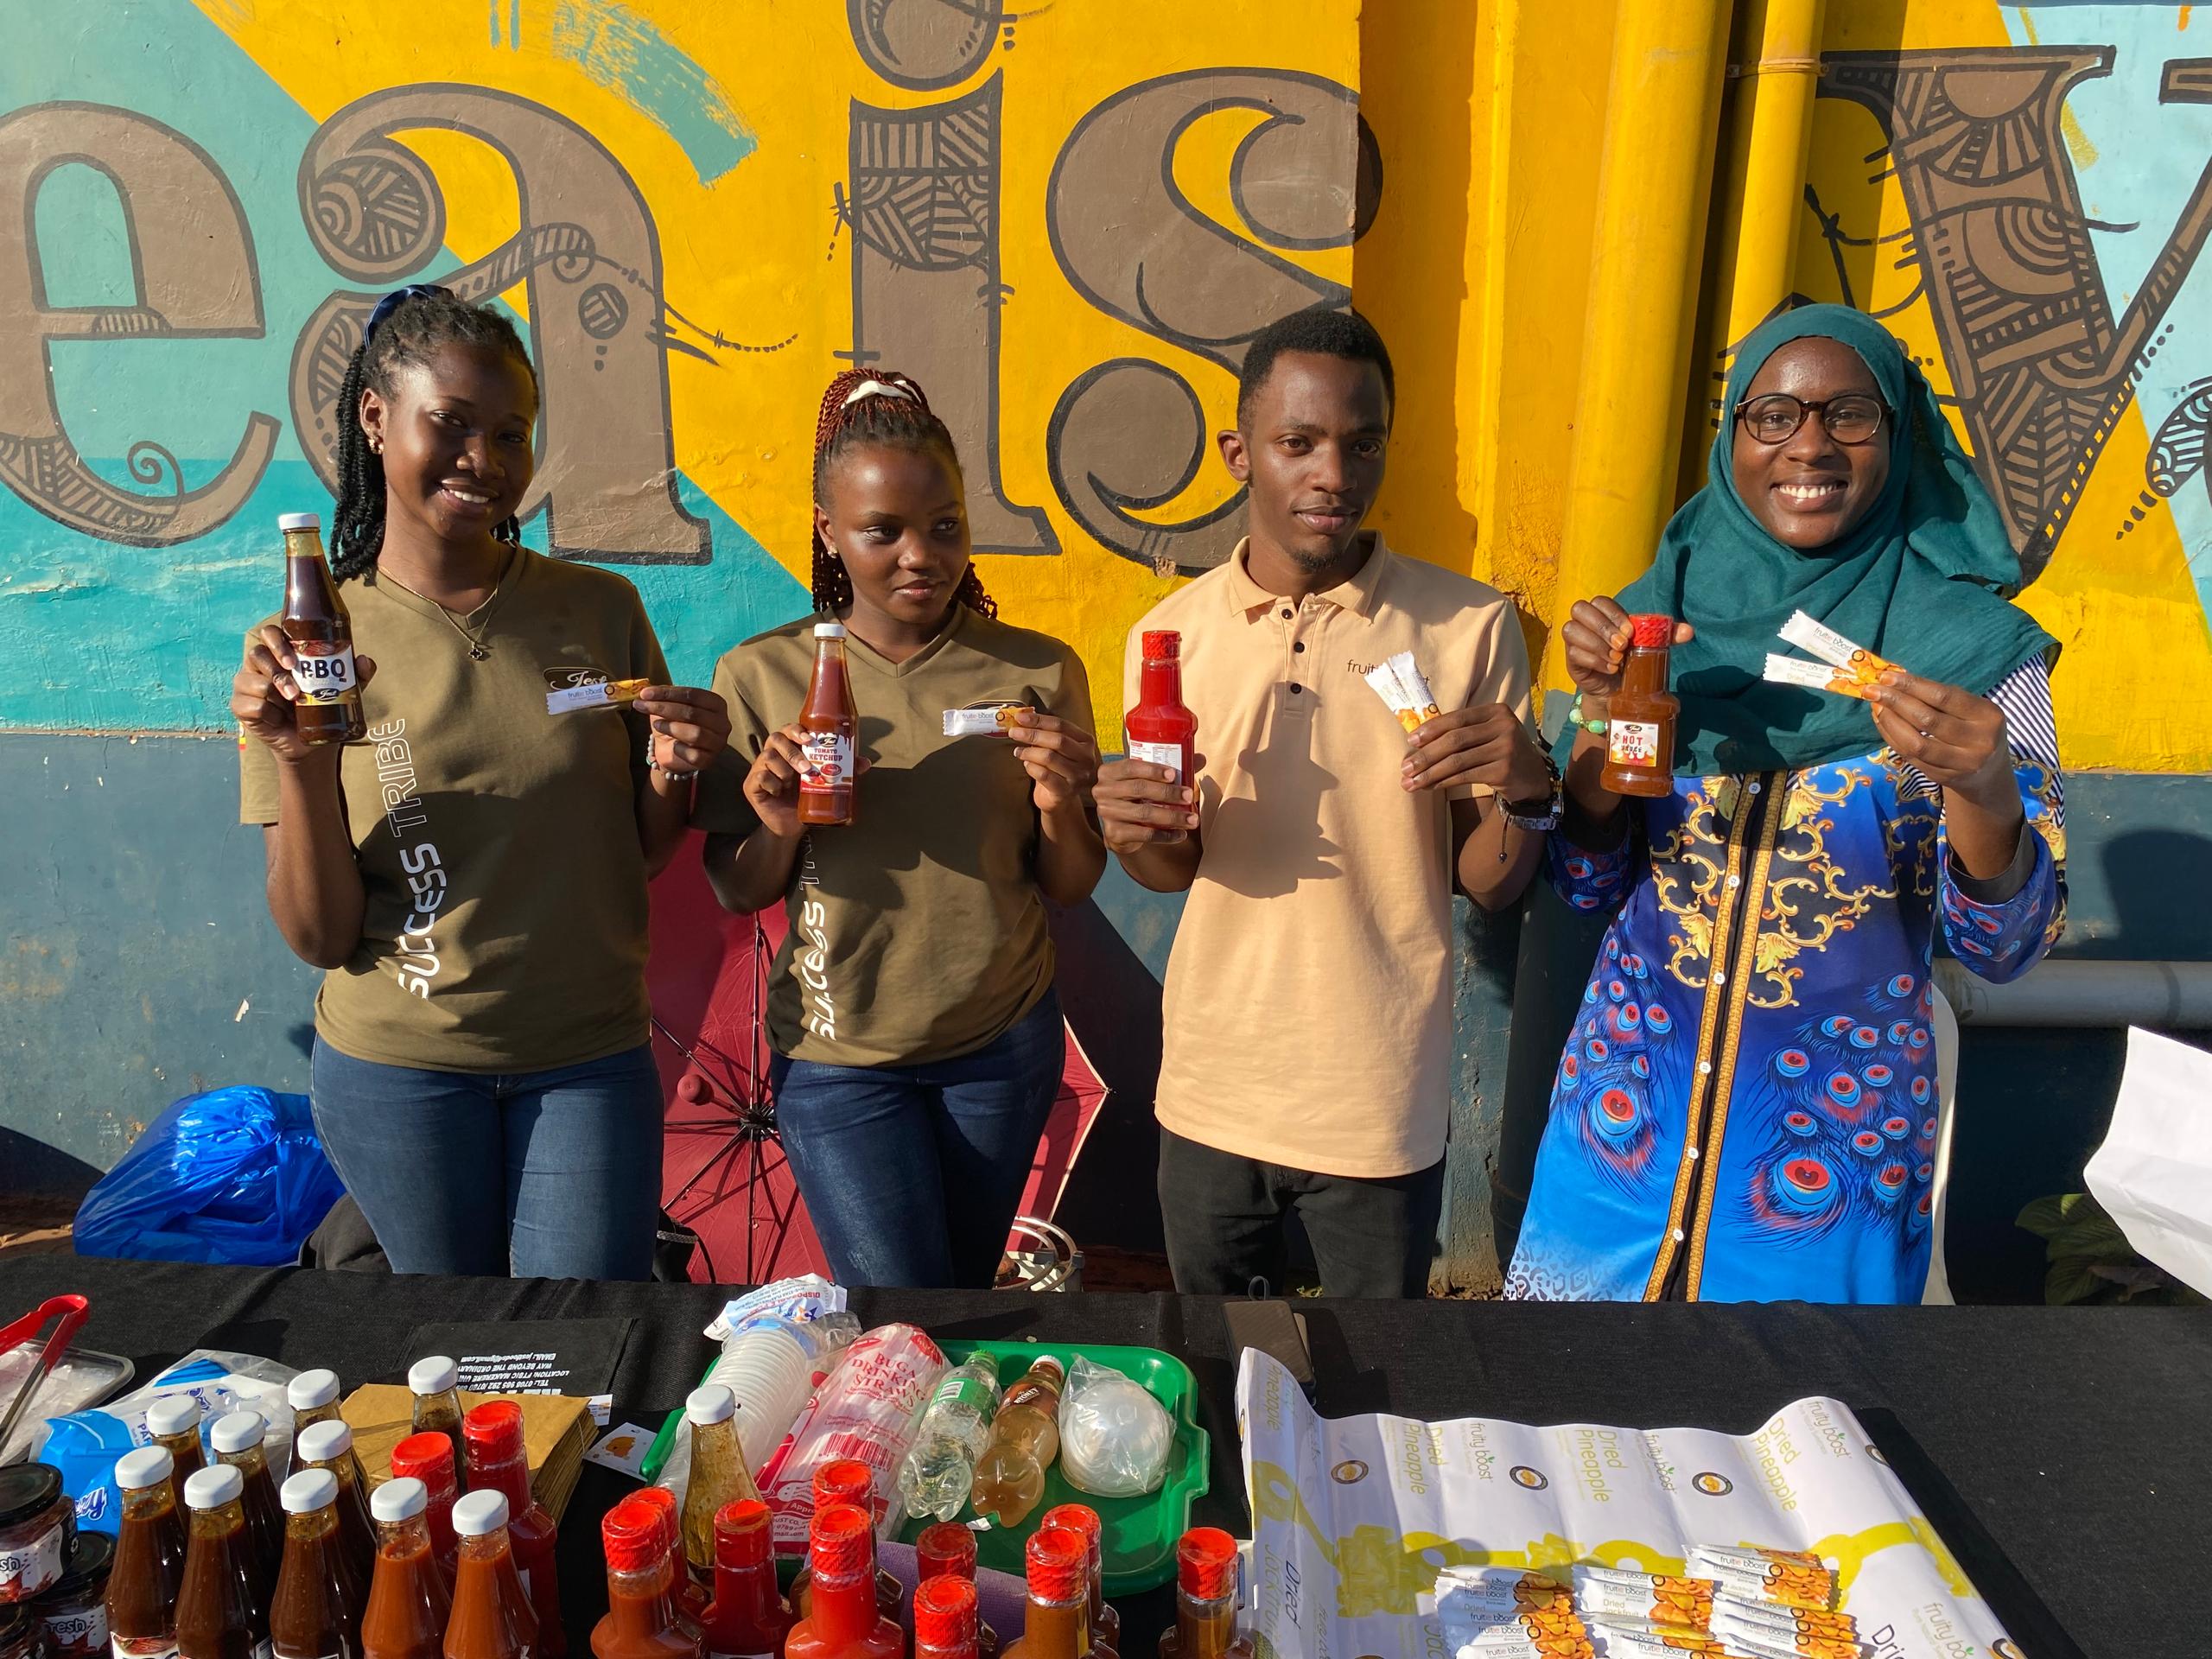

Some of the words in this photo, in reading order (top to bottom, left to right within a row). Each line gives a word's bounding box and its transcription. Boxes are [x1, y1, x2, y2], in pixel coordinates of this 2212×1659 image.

[809, 753, 843, 762] KETCHUP
[1623, 735, 1643, 746] HOT
[367, 718, 427, 838] TRIBE
[397, 842, 448, 1001] SUCCESS
[533, 1370, 570, 1378] LOCATION:
[852, 1358, 926, 1402] DRINKING
[874, 1351, 916, 1378] BUGA
[854, 1373, 914, 1408] STRAWS
[1424, 1427, 1451, 1466] Dried
[1470, 1422, 1485, 1448] fruity
[1769, 1417, 1802, 1465] Dried
[1808, 1401, 1832, 1427] fruity
[1823, 1427, 1850, 1458] boost
[1402, 1423, 1430, 1495] Pineapple
[1475, 1449, 1493, 1480] boost
[1575, 1429, 1613, 1502] Pineapple
[1597, 1430, 1630, 1468] Dried
[1751, 1433, 1797, 1511] Pineapple
[1720, 1555, 1743, 1565] fruitie
[1743, 1560, 1767, 1570] boost
[1286, 1560, 1301, 1630] Dried
[1603, 1599, 1625, 1608] Dried
[1604, 1583, 1624, 1592] fruitie
[1625, 1586, 1647, 1597] boost
[1471, 1612, 1493, 1621] fruitie
[1493, 1613, 1516, 1623] boost
[1478, 1626, 1502, 1635] fruitie
[1501, 1625, 1525, 1635] boost
[1923, 1602, 1955, 1640] fruity
[1946, 1640, 1968, 1659] bo
[1486, 1648, 1508, 1657] fruitie
[1507, 1644, 1530, 1654] boost
[1638, 1643, 1662, 1652] fruitie
[1662, 1646, 1687, 1658] boost
[1872, 1624, 1905, 1659] Dri
